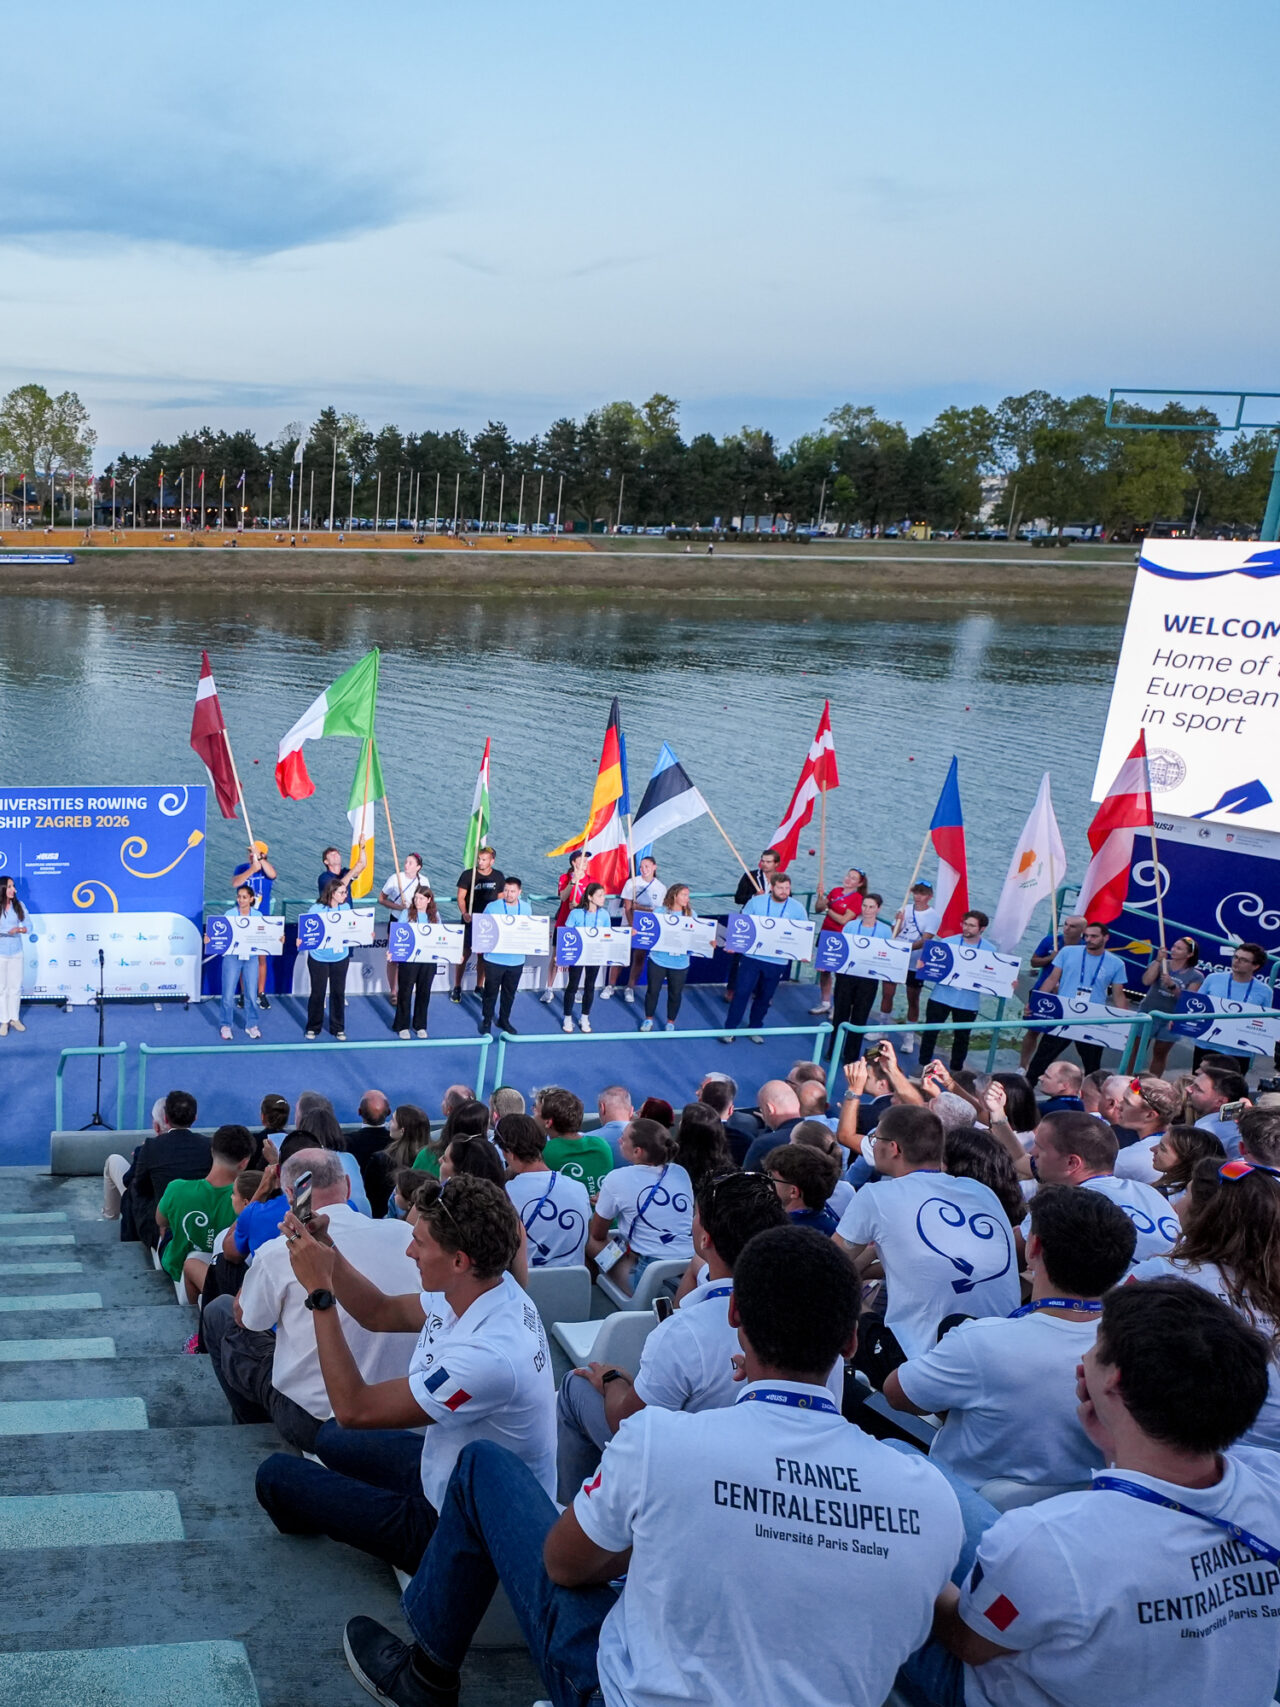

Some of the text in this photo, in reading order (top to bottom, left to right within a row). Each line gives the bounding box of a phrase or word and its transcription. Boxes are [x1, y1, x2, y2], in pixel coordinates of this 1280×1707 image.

[1152, 648, 1274, 676] Home of
[1146, 676, 1279, 708] European
[1140, 703, 1247, 735] in sport
[87, 796, 148, 810] ROWING
[34, 815, 92, 828] ZAGREB
[95, 814, 130, 827] 2026
[1193, 959, 1233, 974] ZAGR
[775, 1457, 862, 1493] FRANCE
[714, 1480, 921, 1535] CENTRALESUPELEC
[755, 1523, 890, 1560] Université Paris Saclay
[1180, 1615, 1228, 1639] Université
[1228, 1604, 1258, 1622] Paris
